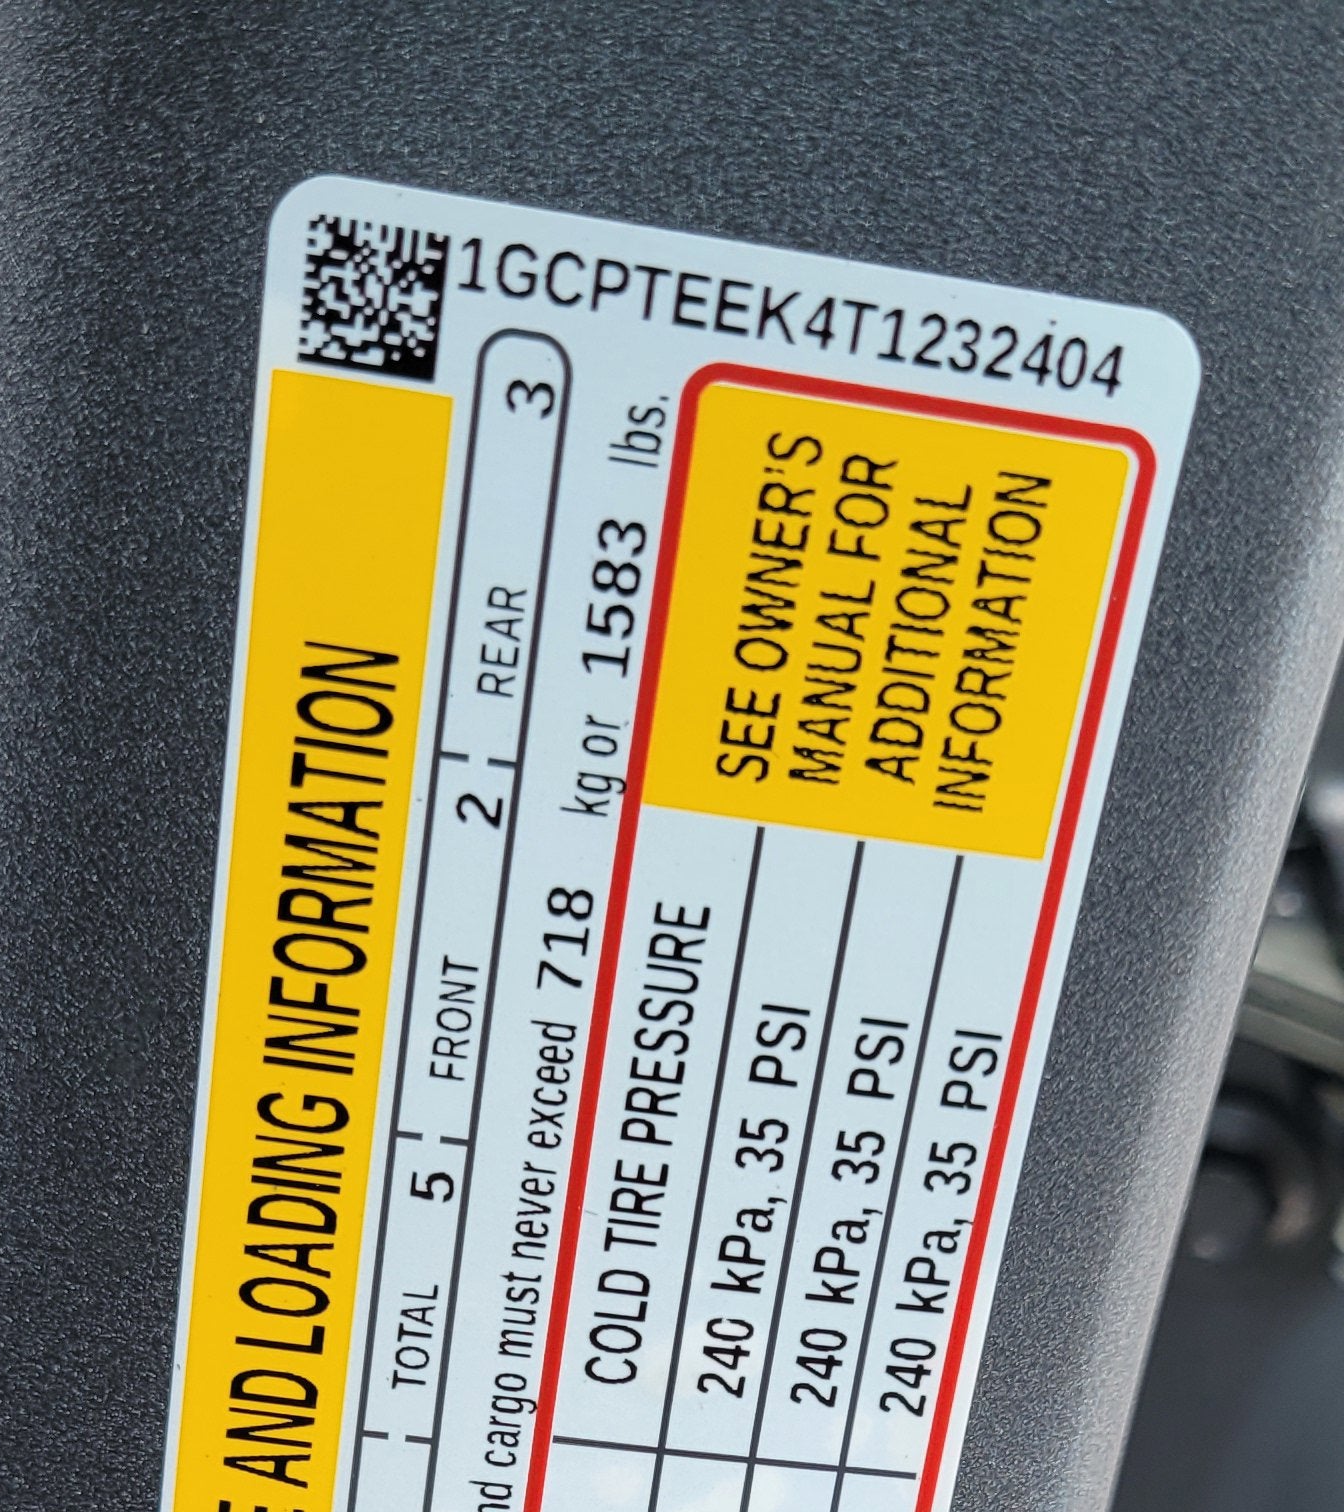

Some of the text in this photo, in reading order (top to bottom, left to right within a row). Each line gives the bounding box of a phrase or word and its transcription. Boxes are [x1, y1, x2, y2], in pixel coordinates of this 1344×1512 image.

[457, 237, 1124, 402] 1GCPTEEK4T1232404
[608, 396, 670, 469] lbs.
[476, 379, 556, 698] REAR 3
[581, 518, 648, 678] 1583
[715, 432, 823, 782] SEE OWNER'S
[788, 454, 897, 785] MANUAL FOR
[864, 485, 972, 784] ADDITIONAL
[933, 471, 1052, 812] INFORMATION
[559, 771, 628, 818] kg
[581, 714, 621, 758] or
[262, 641, 400, 1076] INFORMATION
[428, 792, 504, 1082] FRONT 2
[536, 886, 594, 990] 718
[526, 1019, 578, 1150] exceed
[584, 901, 712, 1385] COLD TIRE PRESSURE
[696, 1003, 811, 1399] 240 kPa, 35 PSI
[235, 1092, 350, 1355] LOADING
[391, 1171, 455, 1390] TOTAL 5
[497, 1271, 543, 1359] must
[511, 1160, 557, 1261] never
[789, 1017, 910, 1408] 240 kPa, 35 PSI
[878, 1029, 1003, 1418] 240 kPa, 35 PSI
[223, 1369, 319, 1489] AND
[484, 1372, 538, 1468] cargo
